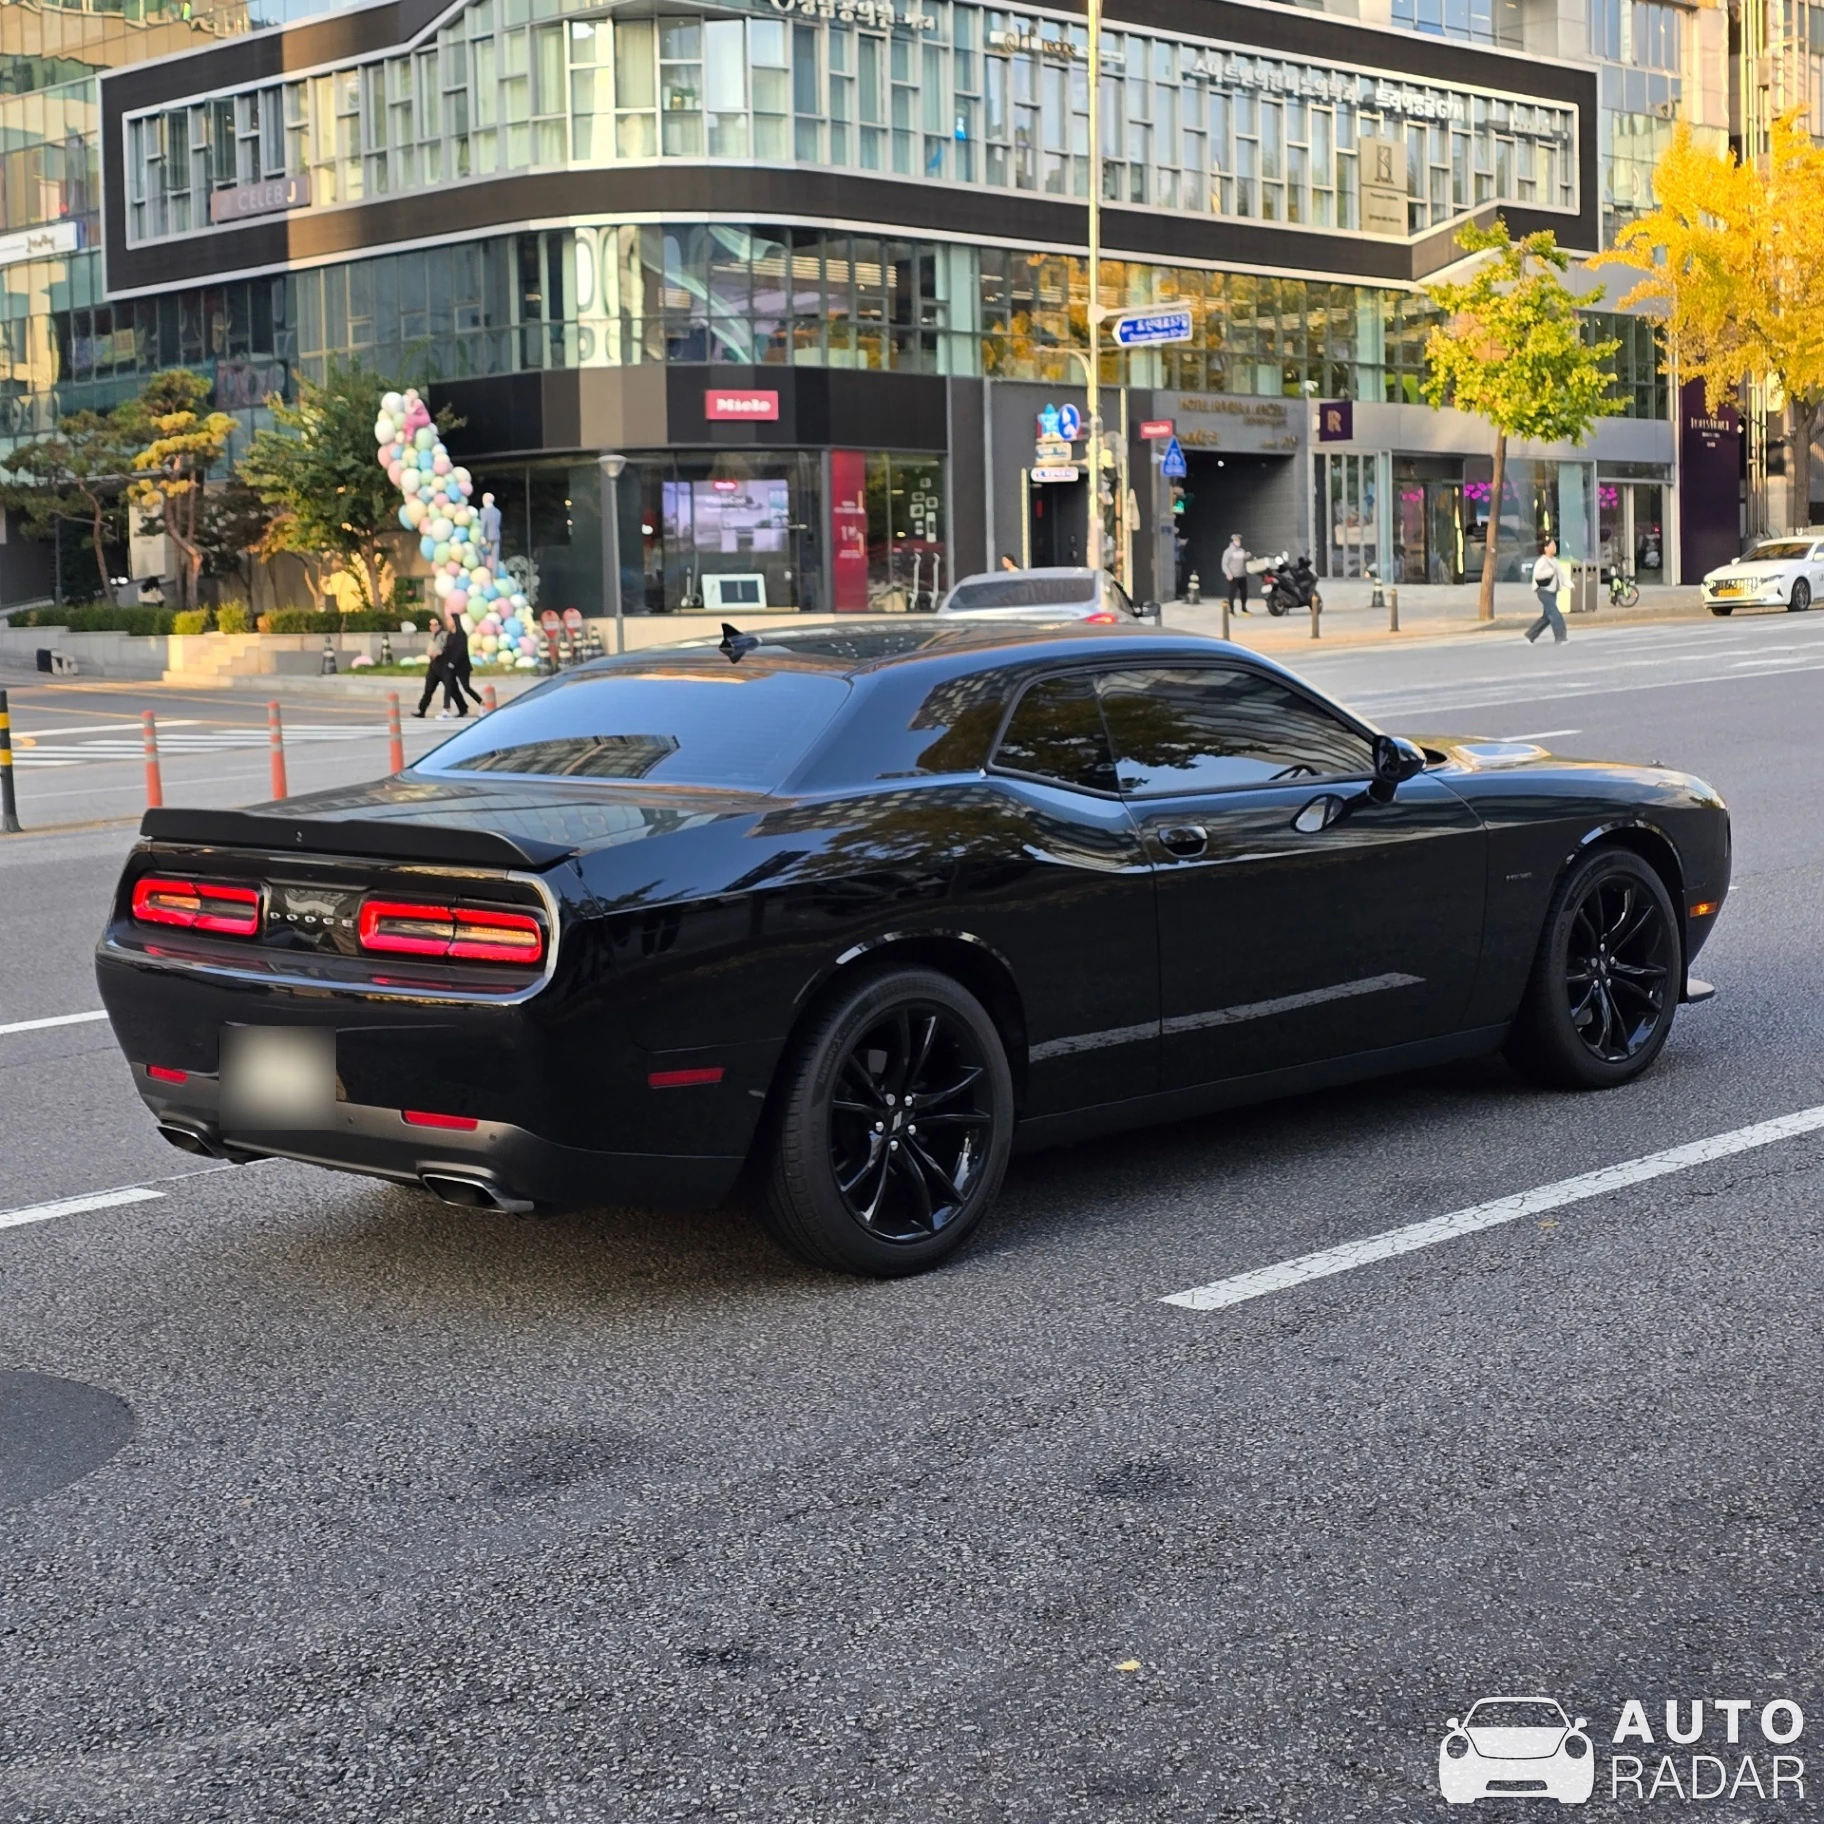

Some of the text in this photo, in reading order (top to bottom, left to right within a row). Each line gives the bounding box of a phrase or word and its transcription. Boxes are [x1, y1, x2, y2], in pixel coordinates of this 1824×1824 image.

[238, 180, 297, 211] CELEB J
[716, 398, 772, 413] Miele
[269, 911, 355, 929] DODGE
